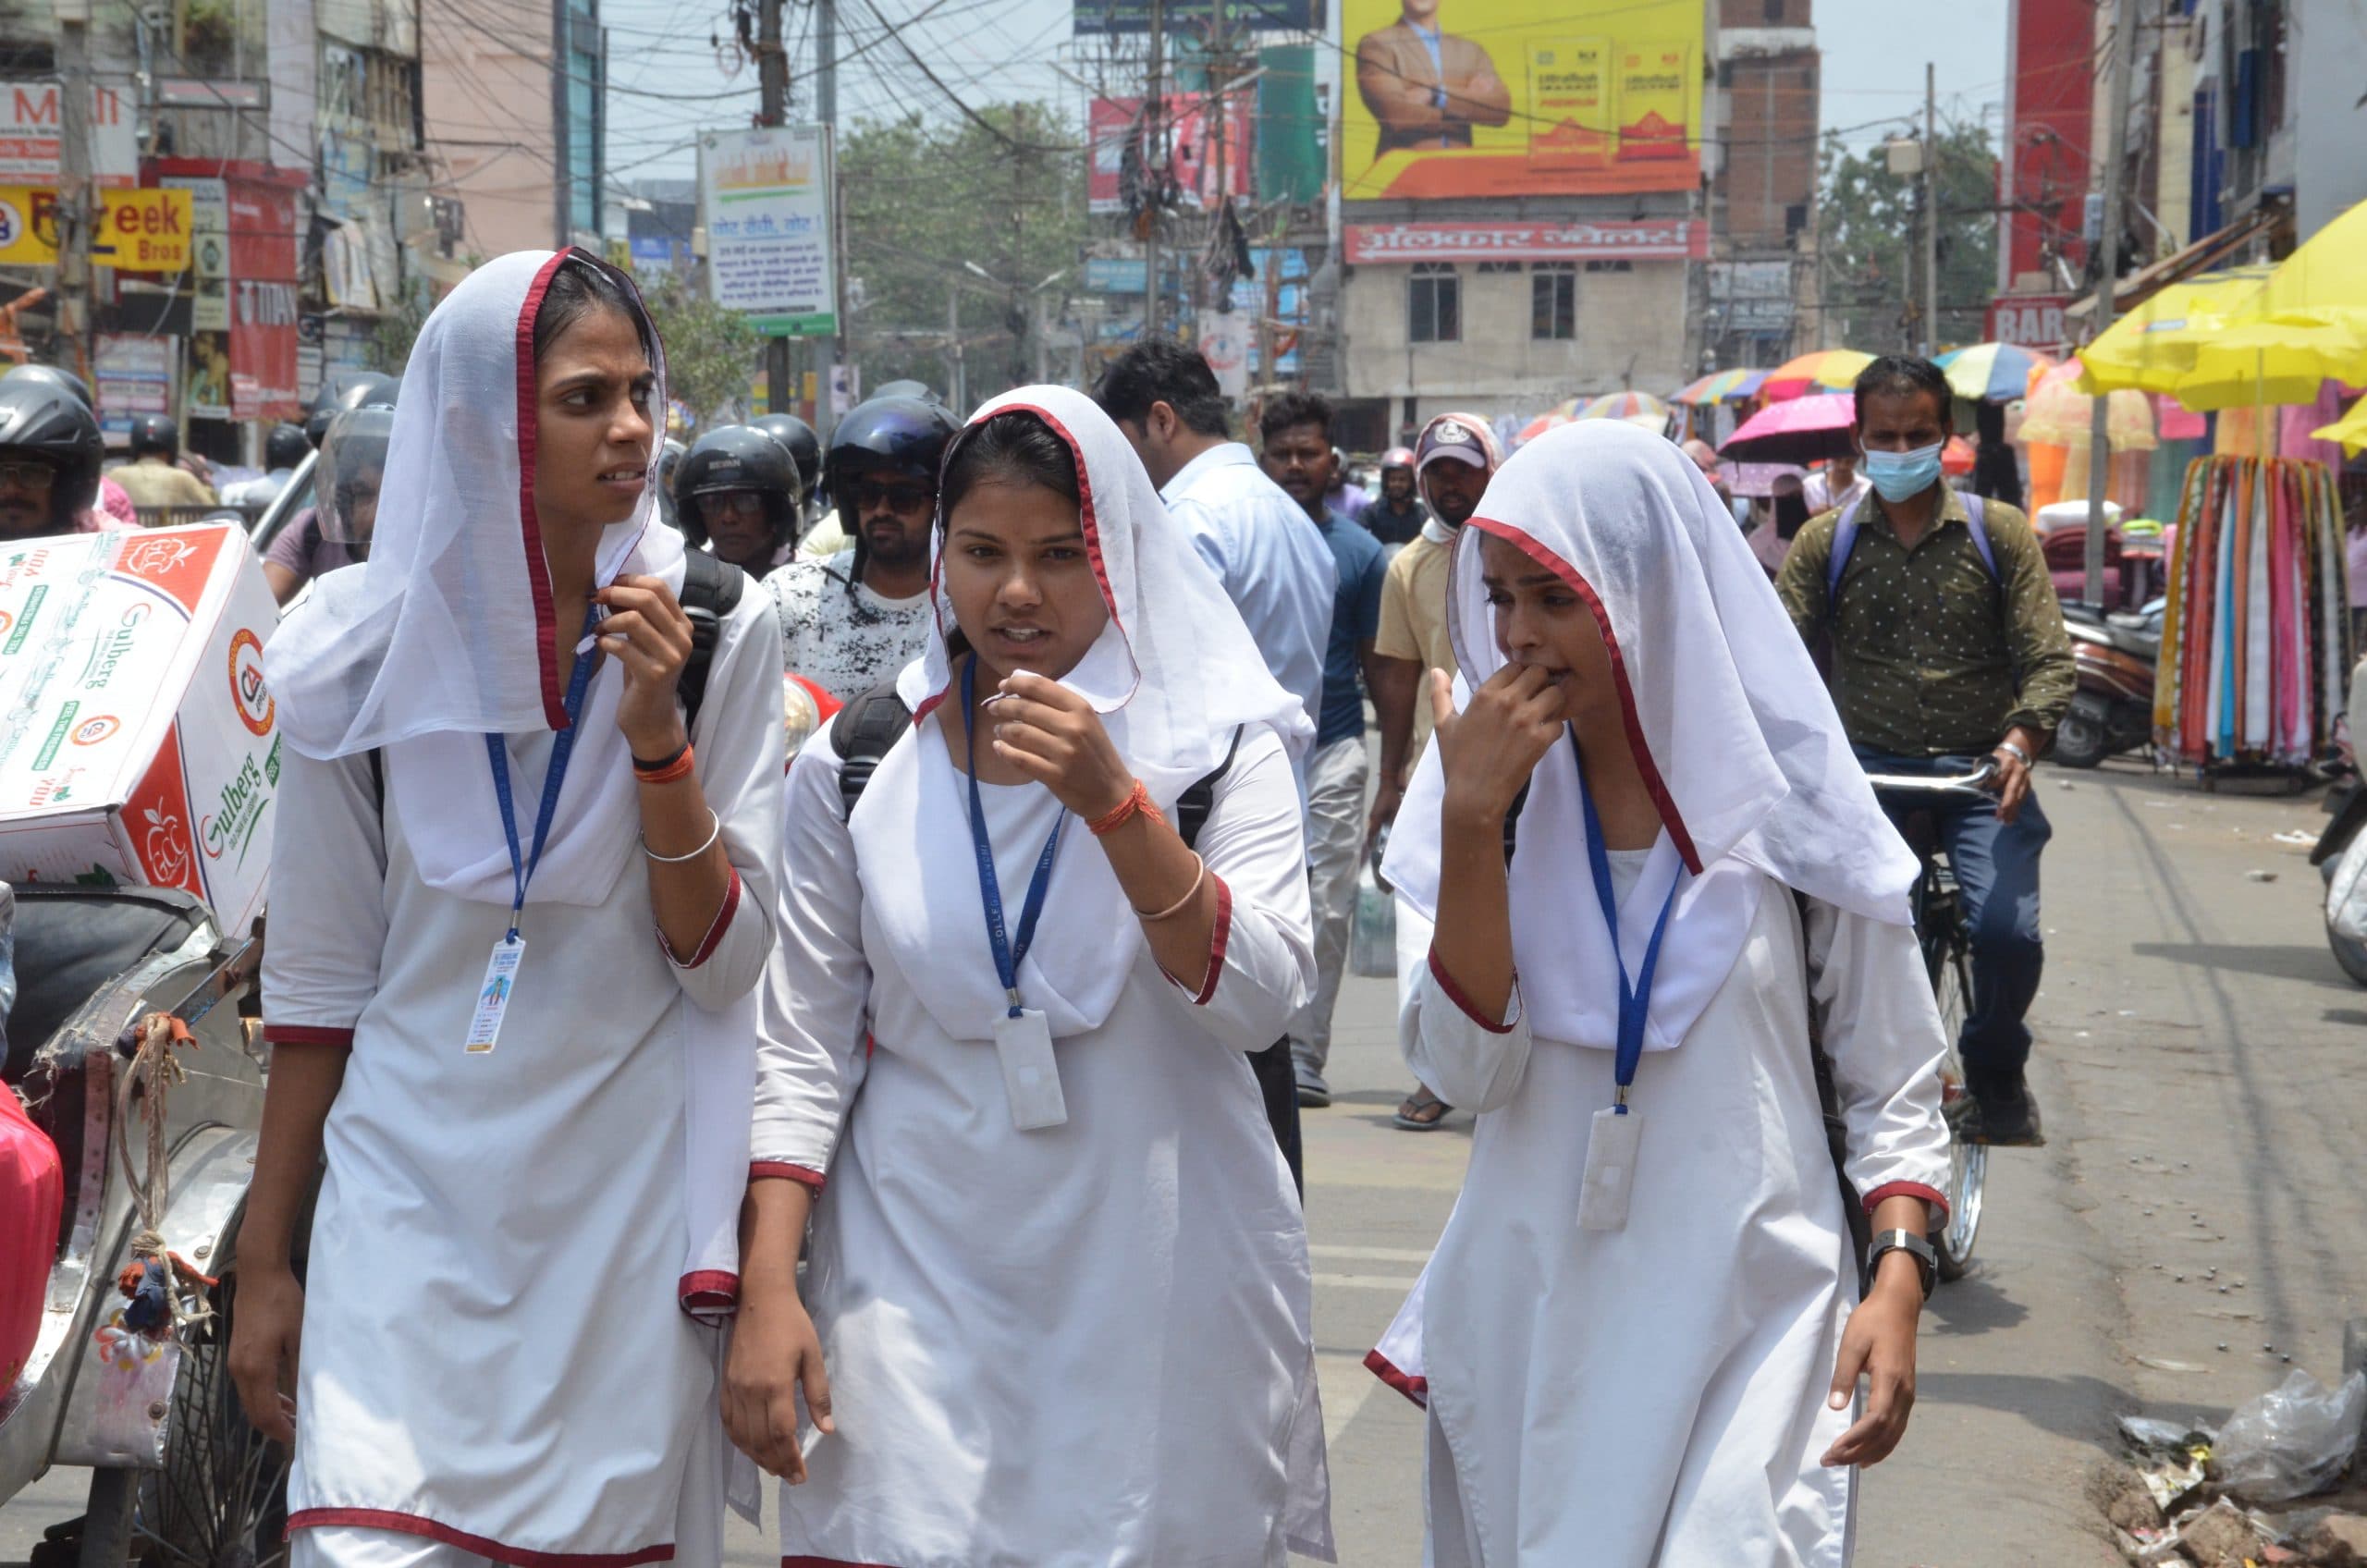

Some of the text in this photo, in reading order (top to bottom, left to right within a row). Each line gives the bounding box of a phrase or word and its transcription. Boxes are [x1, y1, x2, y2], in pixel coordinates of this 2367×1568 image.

[14, 88, 118, 125] Mll
[138, 239, 182, 262] Bros
[1995, 307, 2065, 342] BAR
[85, 603, 151, 690] Gulberg
[201, 753, 262, 861] Gulberg
